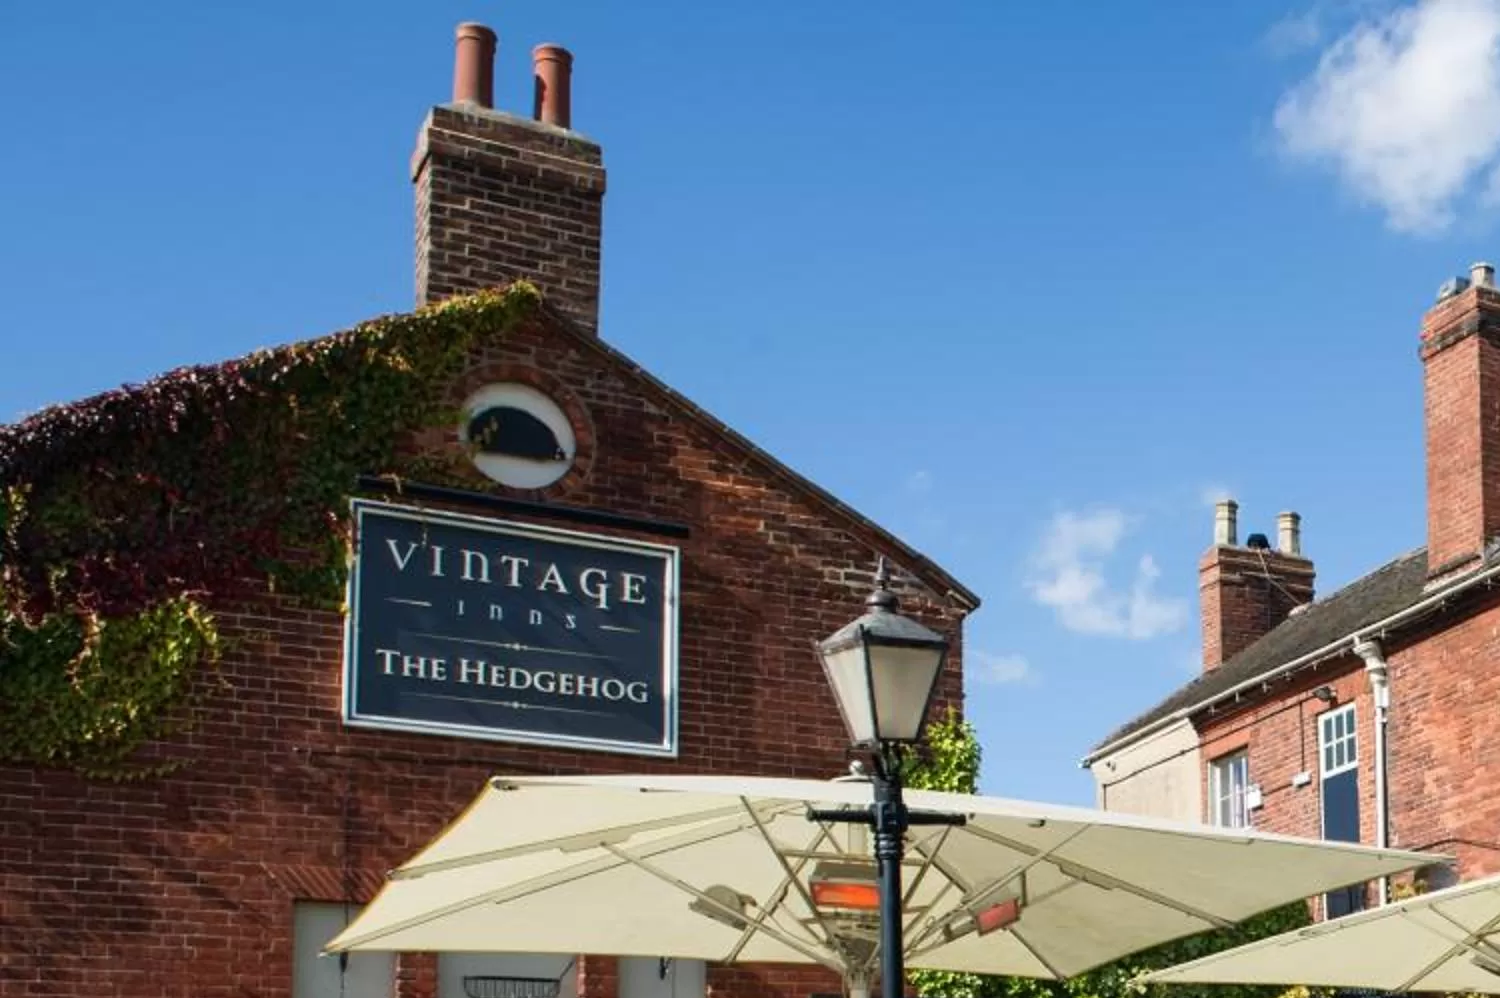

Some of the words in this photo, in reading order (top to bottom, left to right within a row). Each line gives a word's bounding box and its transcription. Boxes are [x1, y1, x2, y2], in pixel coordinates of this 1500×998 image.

[386, 538, 647, 609] VINTAGE
[375, 648, 447, 681] THE
[458, 658, 648, 703] HEDGEHOG
